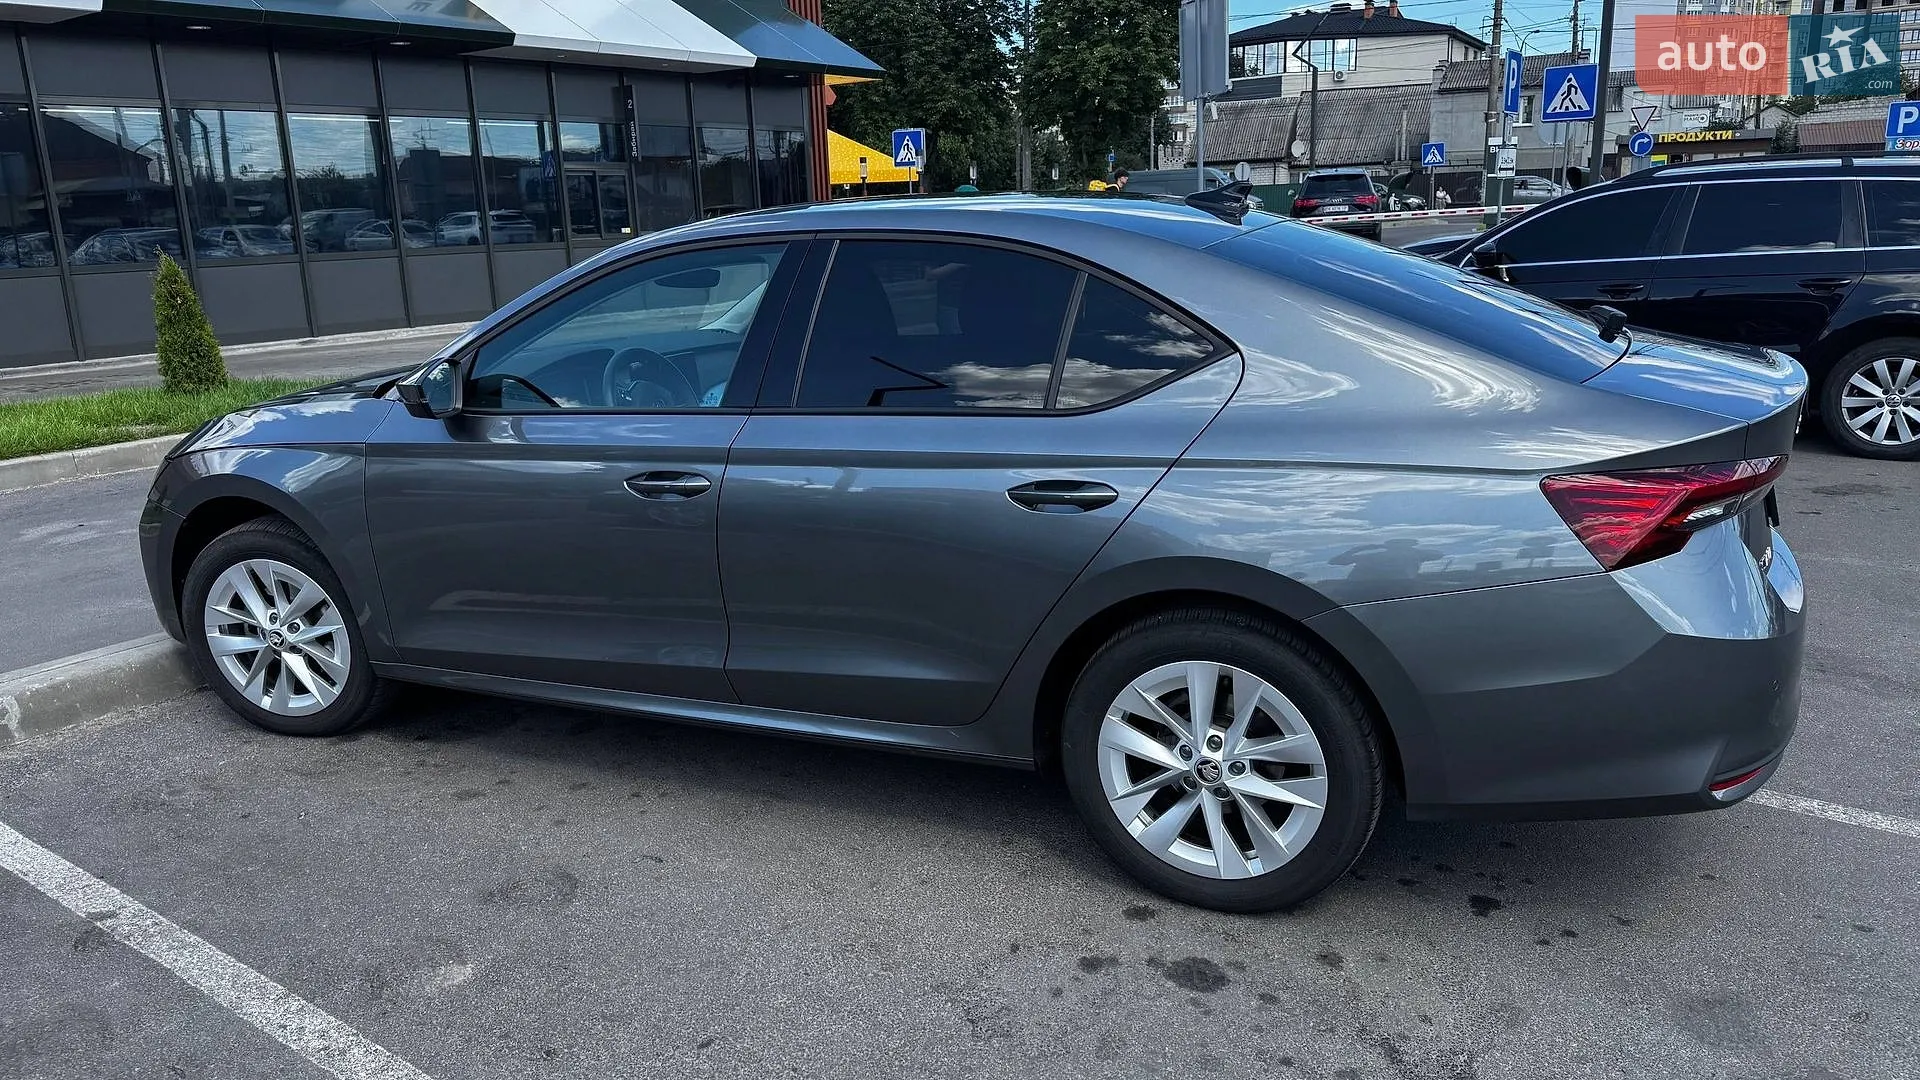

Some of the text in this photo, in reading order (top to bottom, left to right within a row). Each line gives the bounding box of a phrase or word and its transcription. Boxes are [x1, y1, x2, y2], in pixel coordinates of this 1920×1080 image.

[1508, 59, 1518, 106] P
[627, 99, 633, 109] 2
[1897, 106, 1919, 134] P
[630, 121, 638, 157] Забирай
[1658, 130, 1733, 143] ПРОДУКТИ
[1895, 138, 1920, 151] Зор
